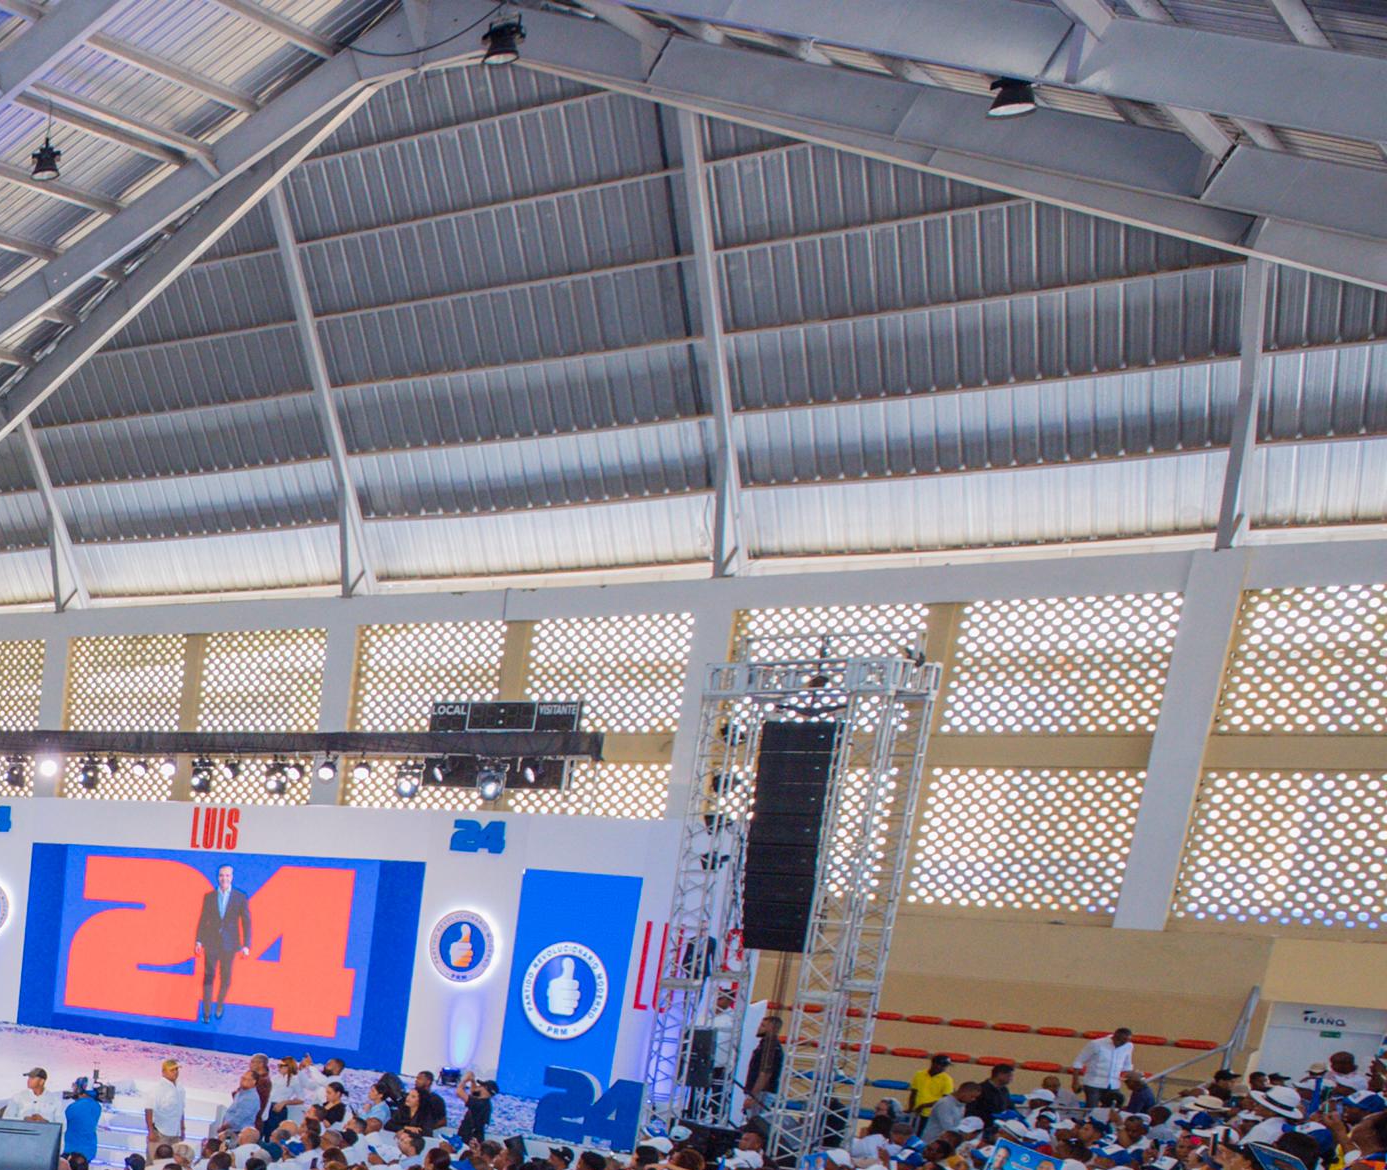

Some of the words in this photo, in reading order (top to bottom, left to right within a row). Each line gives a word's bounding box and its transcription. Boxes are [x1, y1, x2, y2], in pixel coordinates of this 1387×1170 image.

[190, 807, 240, 850] LUIS
[450, 819, 506, 854] 24
[65, 855, 356, 1038] 24
[546, 1025, 569, 1037] PRM
[533, 1066, 645, 1154] 24
